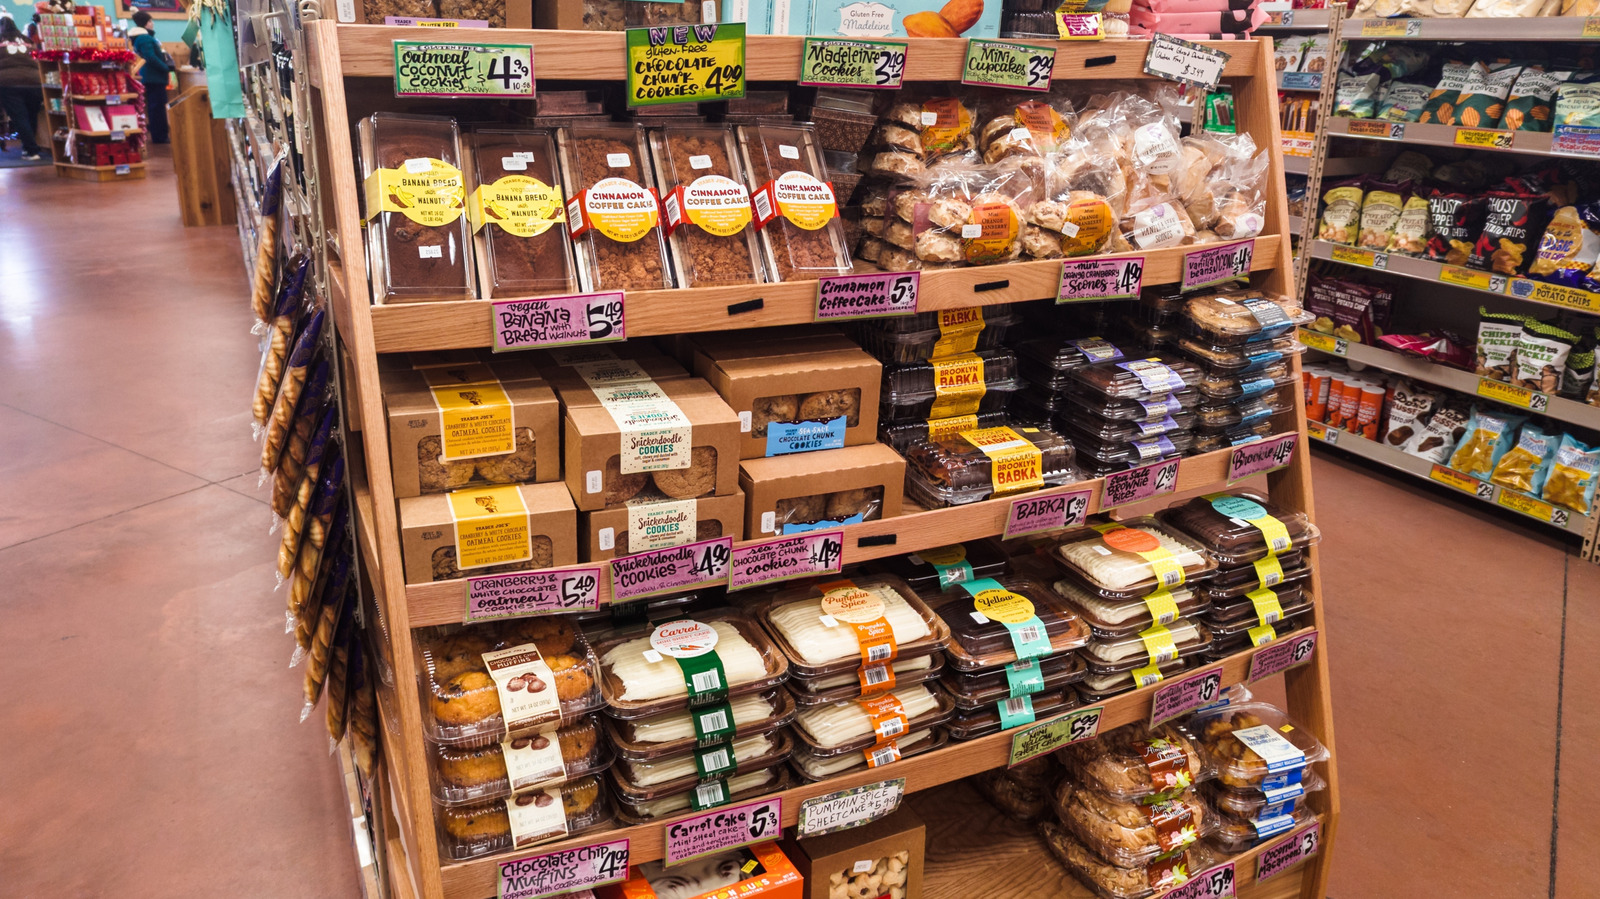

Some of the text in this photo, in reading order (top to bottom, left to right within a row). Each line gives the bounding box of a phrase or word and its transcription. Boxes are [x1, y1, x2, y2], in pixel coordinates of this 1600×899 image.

[850, 10, 885, 18] Gluten Free
[843, 19, 891, 31] Madeleine
[648, 24, 718, 47] NEW
[402, 50, 470, 65] Oatmeal
[808, 46, 880, 64] Madeleine
[635, 57, 717, 74] CHOCOLATE
[811, 61, 865, 78] Cookies
[968, 56, 1026, 76] Cupcakes
[642, 71, 695, 86] CHUNK
[402, 178, 459, 188] BANANA BREAD
[779, 183, 823, 193] CINNAMON
[496, 193, 549, 202] BANANA BREAD
[592, 192, 645, 201] CINNAMON
[690, 188, 742, 198] CINNAMON
[777, 191, 831, 201] COFFEE CAKE
[417, 197, 446, 205] WALNUTS
[588, 200, 654, 210] COFFEE CAKE
[686, 196, 750, 206] COFFEE CAKE
[511, 209, 538, 217] WALNUTS
[1364, 212, 1392, 220] POTATO
[1366, 218, 1389, 227] CHIPS
[1073, 260, 1100, 271] mini
[820, 279, 886, 296] Cinnamon
[1068, 278, 1109, 295] Scones
[1536, 287, 1592, 307] POTATO CHIPS
[507, 301, 550, 315] vegan
[942, 309, 979, 328] BABKA
[549, 323, 571, 334] with
[1480, 331, 1511, 339] CHIPS
[1518, 349, 1553, 363] PICKLE
[938, 358, 978, 368] CHOCOLATE
[940, 365, 978, 377] BROOKLYN
[940, 373, 980, 389] BABKA
[933, 417, 971, 428] CHOCOLATE
[451, 425, 506, 438] OATMEAL COOKIES
[779, 431, 835, 443] CHOCOLATE CHUNK
[799, 427, 811, 435] SEA
[630, 432, 684, 450] Snickerdoodle
[789, 439, 822, 450] COOKIES
[639, 444, 674, 456] COOKIES
[997, 452, 1036, 463] CHOCOLATE
[1233, 446, 1274, 471] Brookie
[997, 459, 1037, 471] BROOKLYN
[997, 467, 1038, 484] BABKA
[1109, 475, 1129, 486] Sea
[1113, 489, 1137, 503] Bites
[1016, 498, 1065, 520] BABKA
[638, 512, 688, 531] Snickerdoodle
[460, 531, 484, 541] CRANBERRY
[503, 526, 528, 536] CHOCOLATE
[646, 523, 680, 535] COOKIES
[466, 533, 522, 547] OATMEAL COOKIES
[747, 537, 806, 556] sea salt
[778, 546, 810, 558] CHUNK
[612, 547, 696, 578] Snickerdoodle
[745, 557, 798, 576] cookies
[548, 574, 559, 582] &
[478, 592, 550, 609] oatmeal
[824, 591, 870, 604] Pumpkin
[978, 593, 1015, 607] Yellow
[841, 599, 868, 609] Spice
[659, 623, 701, 638] Carrot
[858, 621, 887, 631] Pumpkin
[868, 628, 885, 636] Spice
[490, 654, 522, 666] CHOCOLATE
[496, 658, 531, 669] MUFFINS
[808, 795, 859, 818] PUMPKIN
[670, 817, 712, 839] Carrot
[714, 811, 747, 828] Cake
[718, 826, 738, 836] cake
[577, 845, 609, 863] Chip
[739, 878, 771, 893] BUNS
